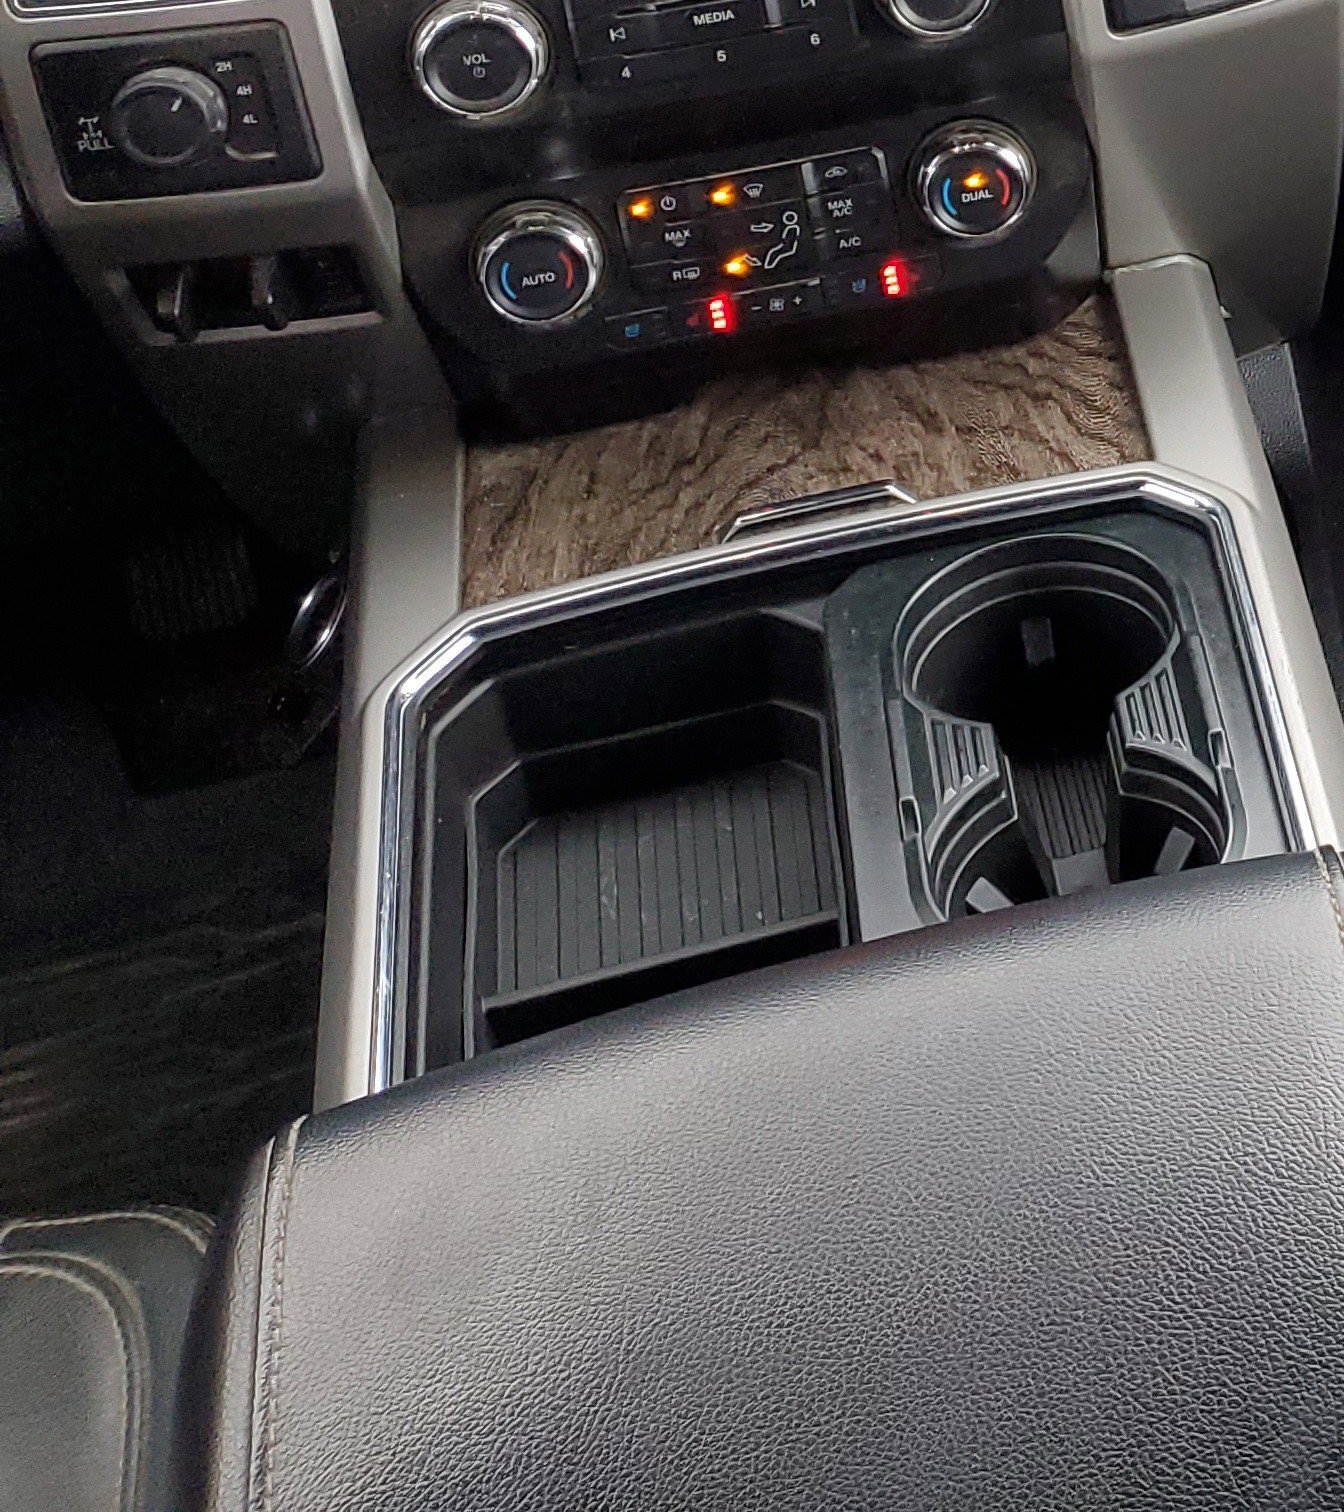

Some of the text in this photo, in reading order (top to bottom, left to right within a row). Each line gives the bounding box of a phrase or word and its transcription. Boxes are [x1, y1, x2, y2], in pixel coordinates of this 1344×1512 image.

[693, 9, 735, 26] MEDIA
[810, 33, 820, 45] 6
[463, 52, 491, 66] VOL
[717, 50, 727, 62] 5
[215, 60, 232, 72] 2H
[621, 66, 631, 78] 4
[236, 84, 252, 96] 4H
[243, 113, 258, 124] 4L
[77, 137, 114, 152] PULL
[961, 189, 994, 203] DUAL
[828, 198, 853, 211] MAX
[832, 206, 852, 218] A/C
[665, 229, 691, 242] MAX
[839, 236, 861, 249] A/C
[522, 272, 555, 288] AUTO
[673, 271, 681, 281] R
